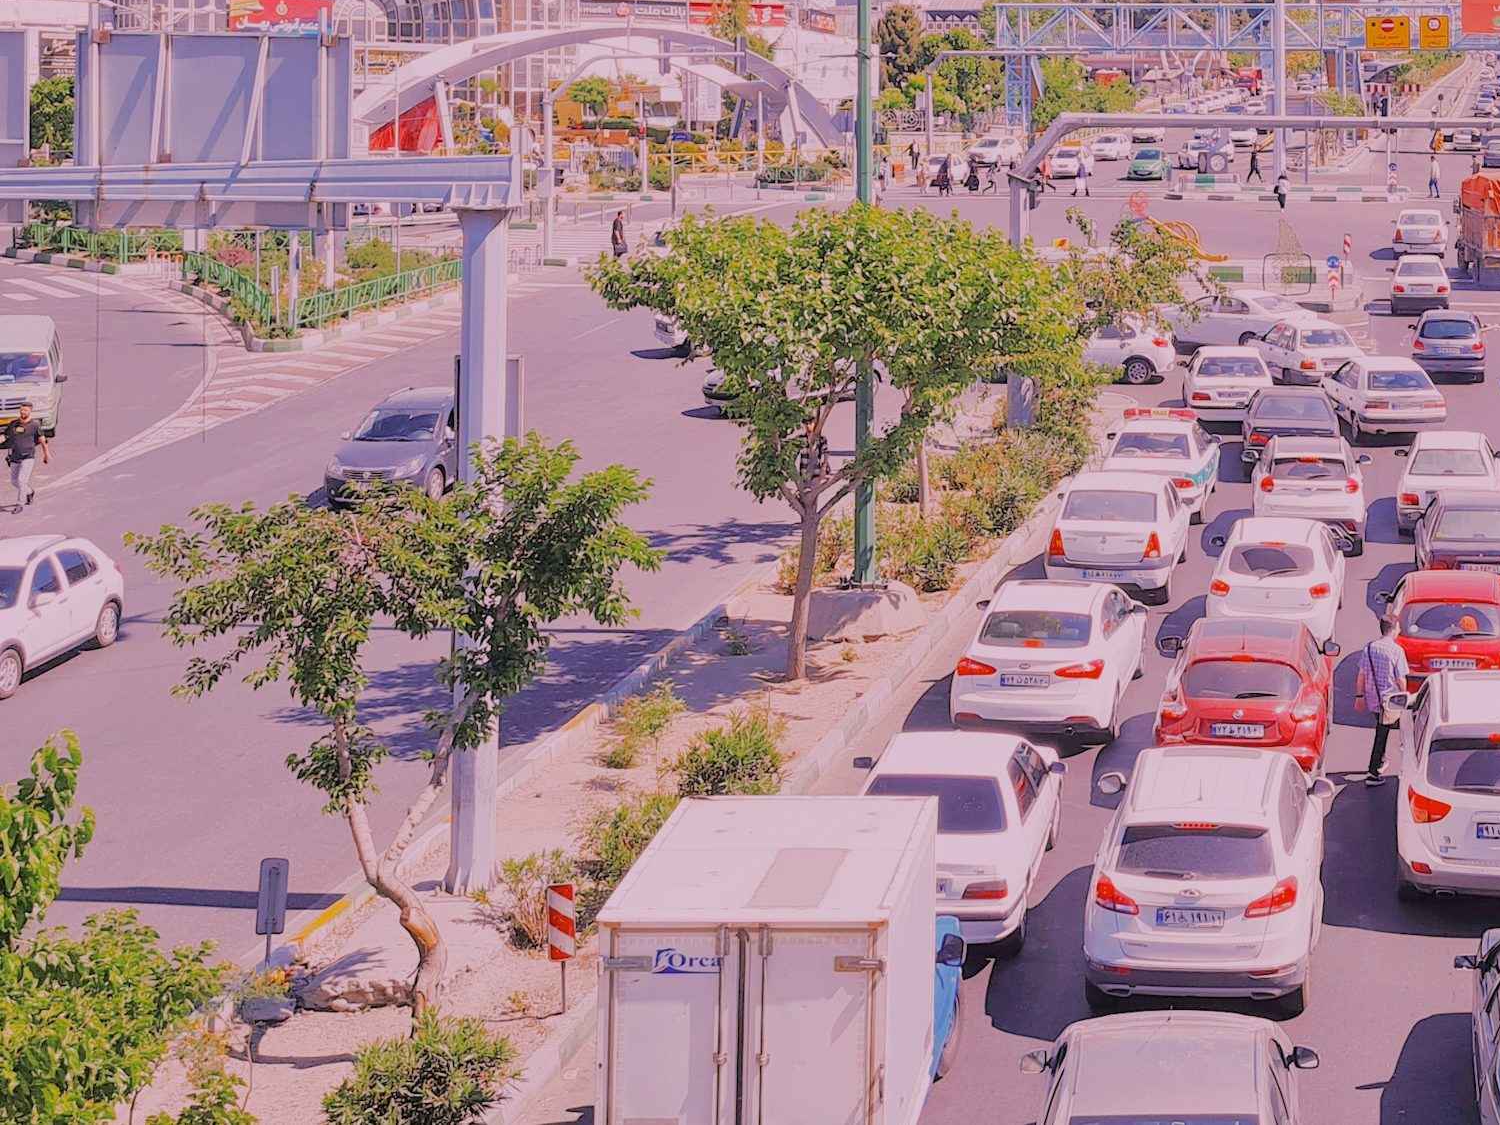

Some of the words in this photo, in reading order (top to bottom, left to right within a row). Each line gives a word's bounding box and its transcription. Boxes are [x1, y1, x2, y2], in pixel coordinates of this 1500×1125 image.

[635, 6, 660, 16] ملت
[661, 6, 685, 17] بانک
[667, 953, 721, 969] Orca
